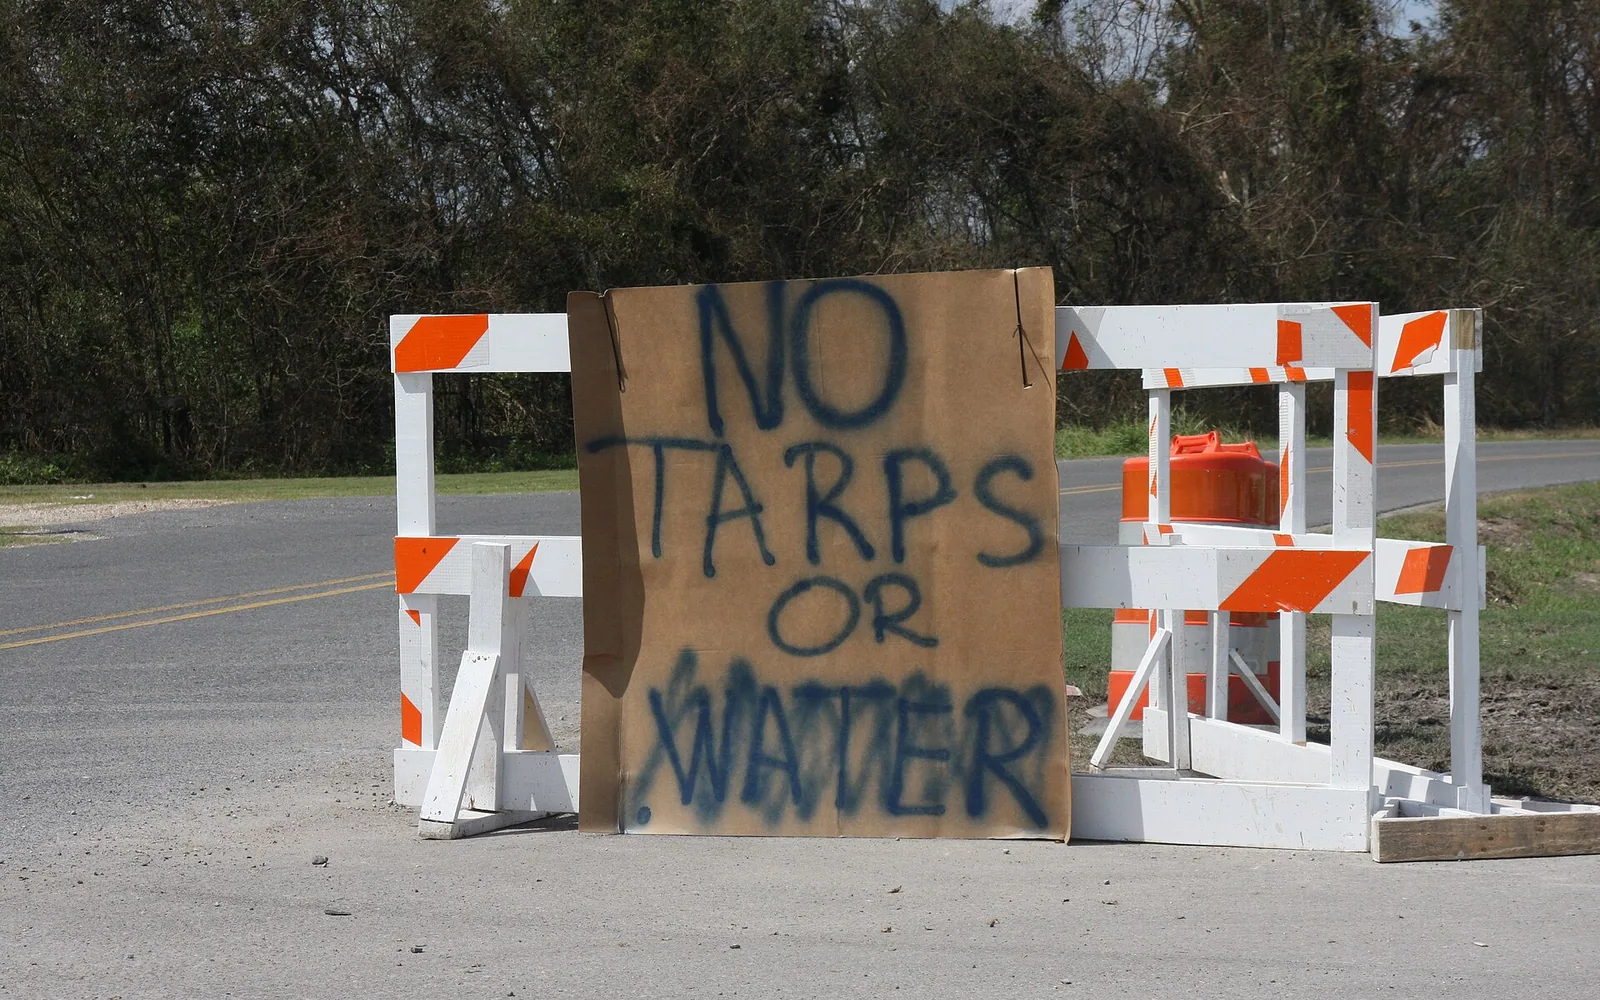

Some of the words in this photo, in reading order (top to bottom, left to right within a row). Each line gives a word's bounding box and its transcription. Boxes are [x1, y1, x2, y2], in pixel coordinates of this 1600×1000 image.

[695, 278, 908, 436] NO
[584, 436, 1047, 578] TARPS
[767, 573, 939, 657] OR
